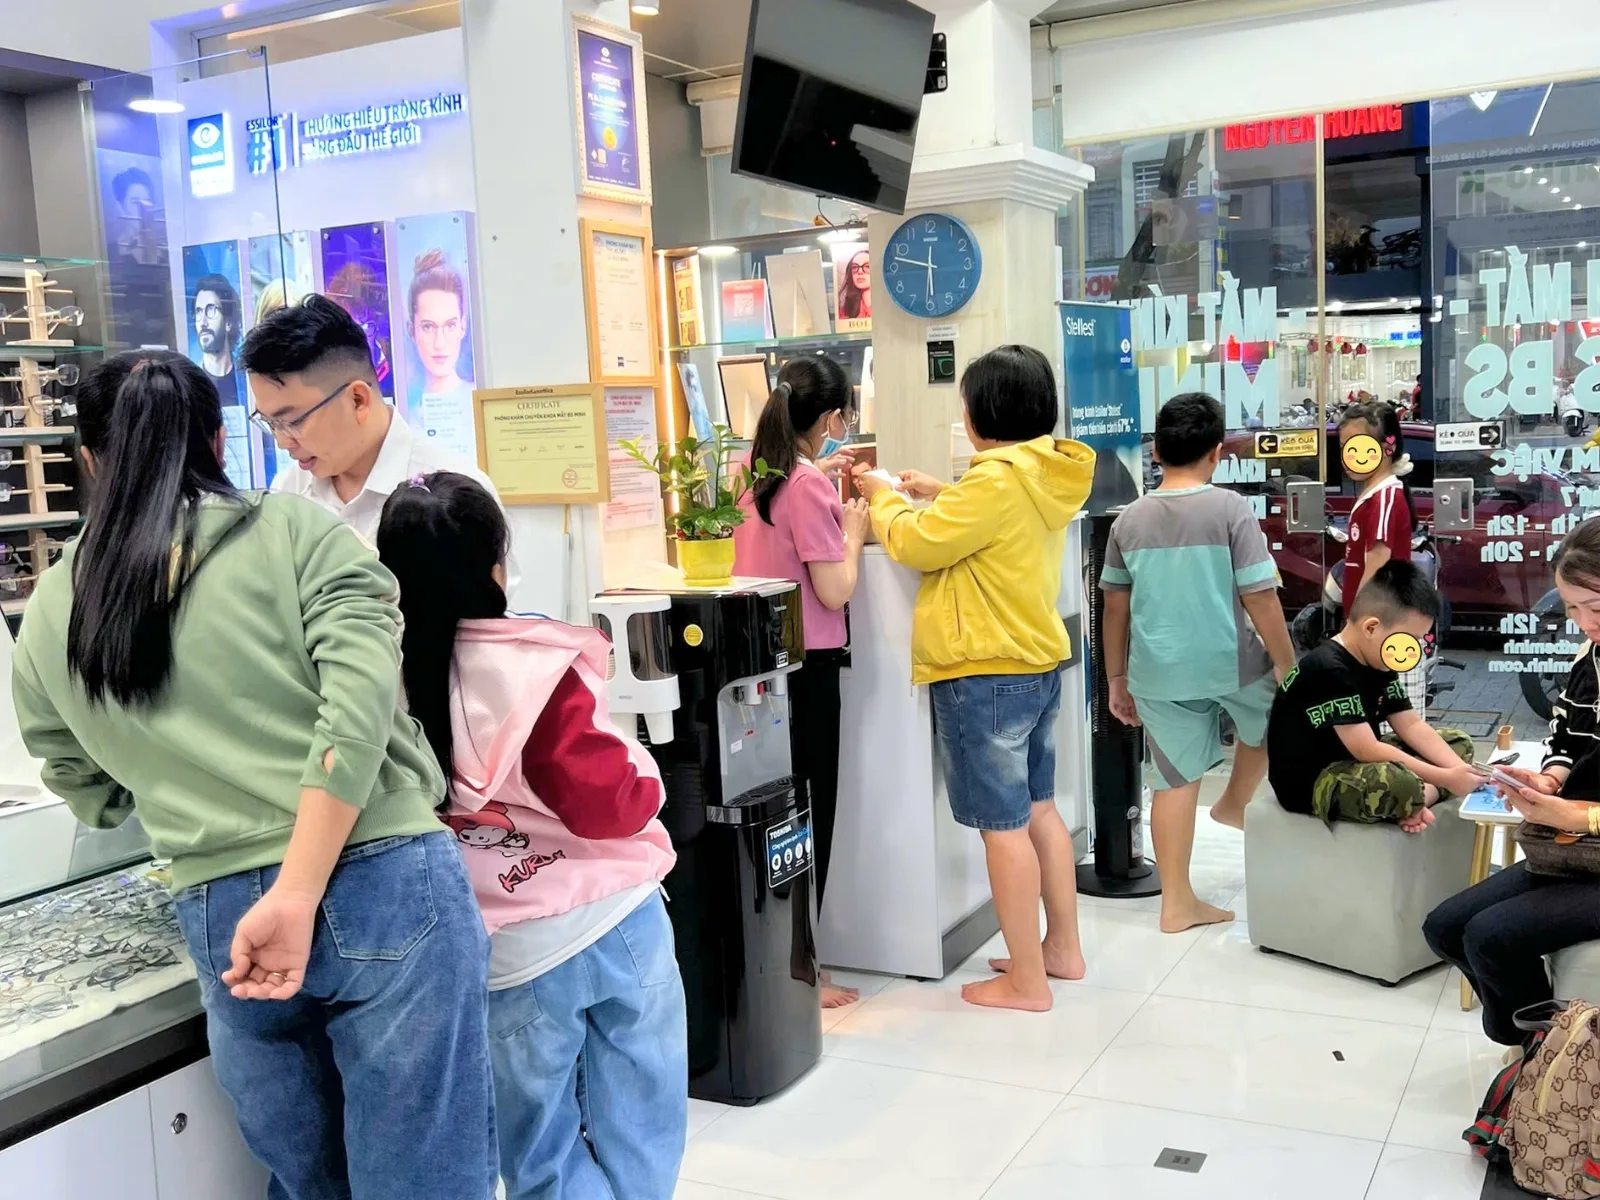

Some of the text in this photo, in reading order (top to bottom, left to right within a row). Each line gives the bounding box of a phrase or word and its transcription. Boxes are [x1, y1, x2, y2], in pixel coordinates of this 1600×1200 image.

[430, 92, 463, 114] KÍNH
[246, 117, 279, 132] ESSILOR
[924, 220, 936, 233] 12
[949, 224, 953, 238] 1
[906, 227, 915, 240] 11
[896, 243, 909, 256] 10
[958, 239, 967, 252] 2
[889, 262, 899, 276] 9
[963, 257, 972, 270] 3
[896, 280, 904, 293] 8
[958, 277, 966, 288] 4
[909, 294, 917, 308] 7
[925, 298, 935, 311] 6
[944, 292, 953, 305] 5
[517, 400, 560, 410] CERTIFICATE
[1457, 429, 1476, 437] QUA
[1298, 436, 1315, 444] QUA
[769, 824, 792, 840] TOSHIBA
